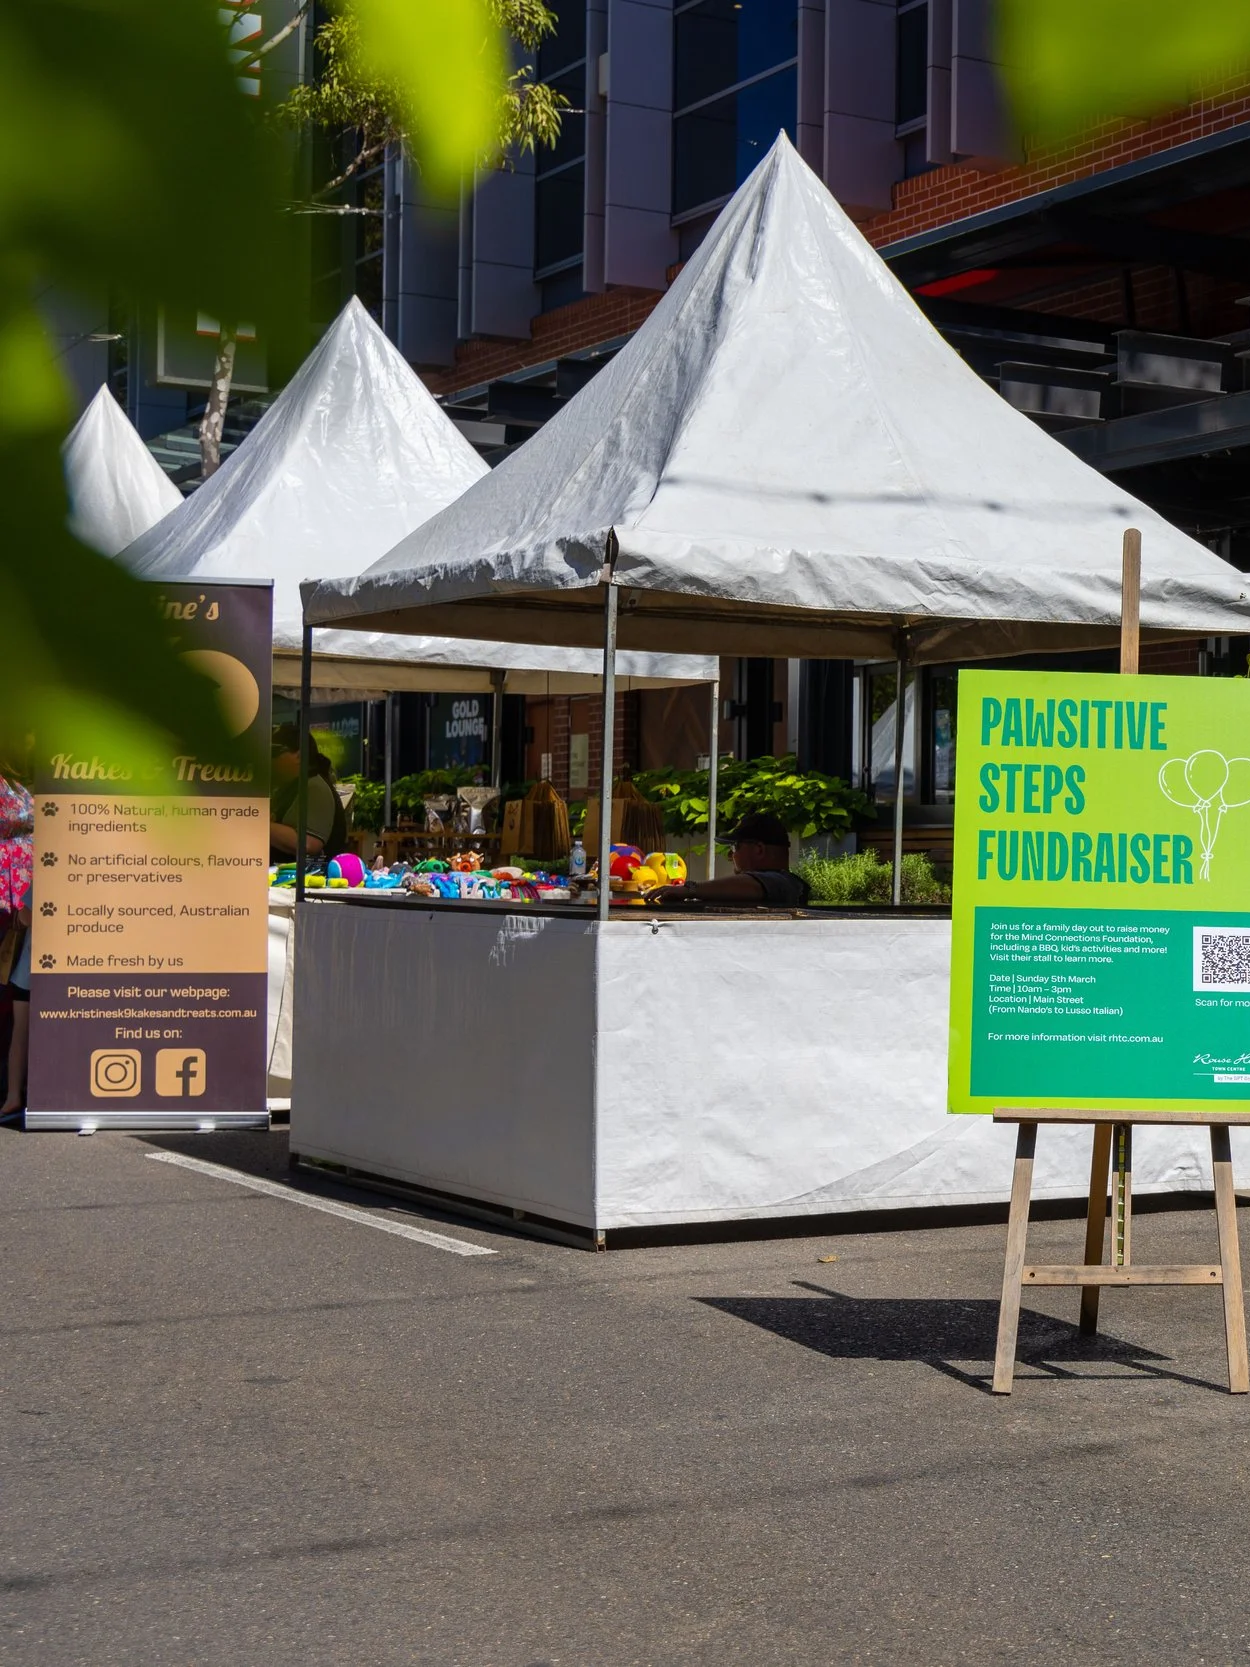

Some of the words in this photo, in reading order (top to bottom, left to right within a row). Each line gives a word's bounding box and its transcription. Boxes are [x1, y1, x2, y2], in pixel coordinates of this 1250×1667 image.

[452, 699, 479, 719] GOLD
[446, 717, 484, 738] LOUNGE
[980, 697, 1168, 751] PAWSITIVE
[51, 753, 132, 780] Kakes
[979, 763, 1086, 816] STEPS
[71, 804, 110, 816] 100%
[114, 804, 169, 818] Natural,
[172, 805, 217, 816] human
[221, 806, 259, 820] grade
[68, 820, 147, 833] ingredients
[68, 855, 86, 866] No
[90, 854, 147, 866] artificial
[151, 855, 204, 867] colours,
[208, 855, 262, 867] flavours
[977, 829, 1194, 885] FUNDRAISER
[67, 873, 83, 882] or
[87, 871, 182, 885] preservatives
[67, 905, 114, 918] Locally
[118, 906, 176, 917] sourced,
[180, 905, 249, 916] Australian
[67, 922, 124, 935] produce
[1043, 923, 1071, 933] family
[1072, 924, 1087, 933] day
[1117, 925, 1138, 933] raise
[1140, 926, 1170, 935] money
[1005, 933, 1020, 941] the
[1045, 934, 1100, 942] Connections
[1102, 935, 1153, 944] Foundation,
[990, 943, 1030, 953] including
[1082, 945, 1122, 953] activities
[1142, 946, 1168, 954] more!
[67, 955, 104, 967] Made
[108, 955, 144, 967] fresh
[149, 955, 164, 969] by
[168, 958, 183, 967] us
[1011, 954, 1031, 962] their
[1033, 954, 1051, 962] stall
[1065, 955, 1087, 963] learn
[1016, 975, 1049, 984] Sunday
[67, 986, 110, 998] Please
[113, 987, 141, 998] visit
[144, 989, 167, 998] our
[171, 987, 230, 1001] webpage:
[1017, 985, 1042, 993] 10am
[1051, 986, 1072, 994] 3pm
[989, 995, 1027, 1003] Location
[1057, 996, 1084, 1004] Street
[1195, 998, 1218, 1008] Scan
[1219, 998, 1233, 1008] for
[40, 1008, 257, 1019] www.kristinesk9kakesandtreats.com.au
[988, 1005, 1016, 1014] (From
[1066, 1007, 1091, 1015] Lusso
[1093, 1007, 1123, 1016] Italian)
[115, 1027, 142, 1039] Find
[146, 1030, 160, 1039] us
[164, 1029, 183, 1039] on:
[1088, 1034, 1107, 1042] visit
[1109, 1035, 1164, 1043] rhtc.com.au
[1193, 1053, 1232, 1064] Rouse
